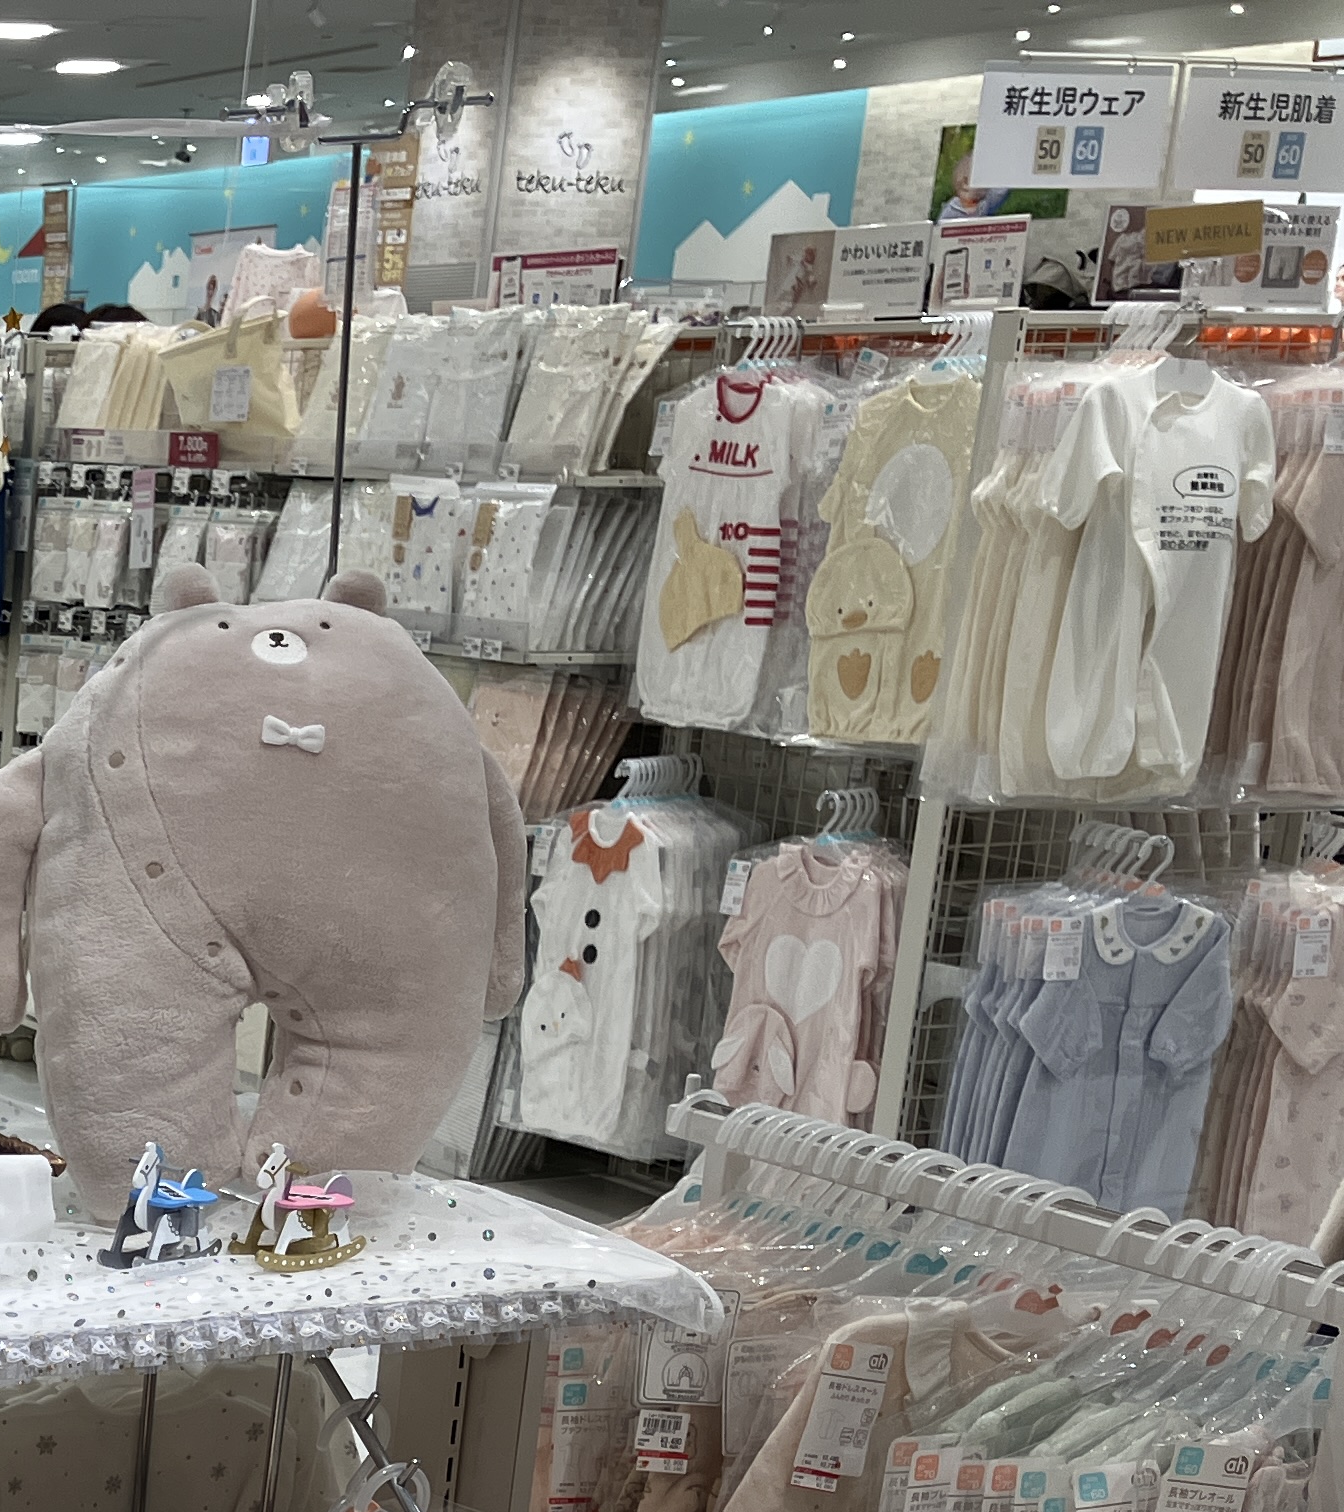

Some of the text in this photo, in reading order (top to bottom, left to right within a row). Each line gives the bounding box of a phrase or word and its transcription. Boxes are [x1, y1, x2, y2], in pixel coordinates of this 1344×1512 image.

[1004, 86, 1146, 117] 新生児ウェア
[1218, 91, 1337, 124] 新生児肌着
[1038, 140, 1099, 161] 50 60
[1242, 145, 1300, 165] 50 60
[415, 176, 482, 201] eku-teku
[516, 169, 625, 194] teku-teku
[1154, 222, 1252, 246] NEW ARRIVAL
[840, 240, 924, 262] かわいいは正義
[709, 439, 760, 469] MILK
[868, 1352, 889, 1370] ah
[1224, 1455, 1249, 1475] ah
[1167, 1486, 1235, 1504] 長袖プレオール
